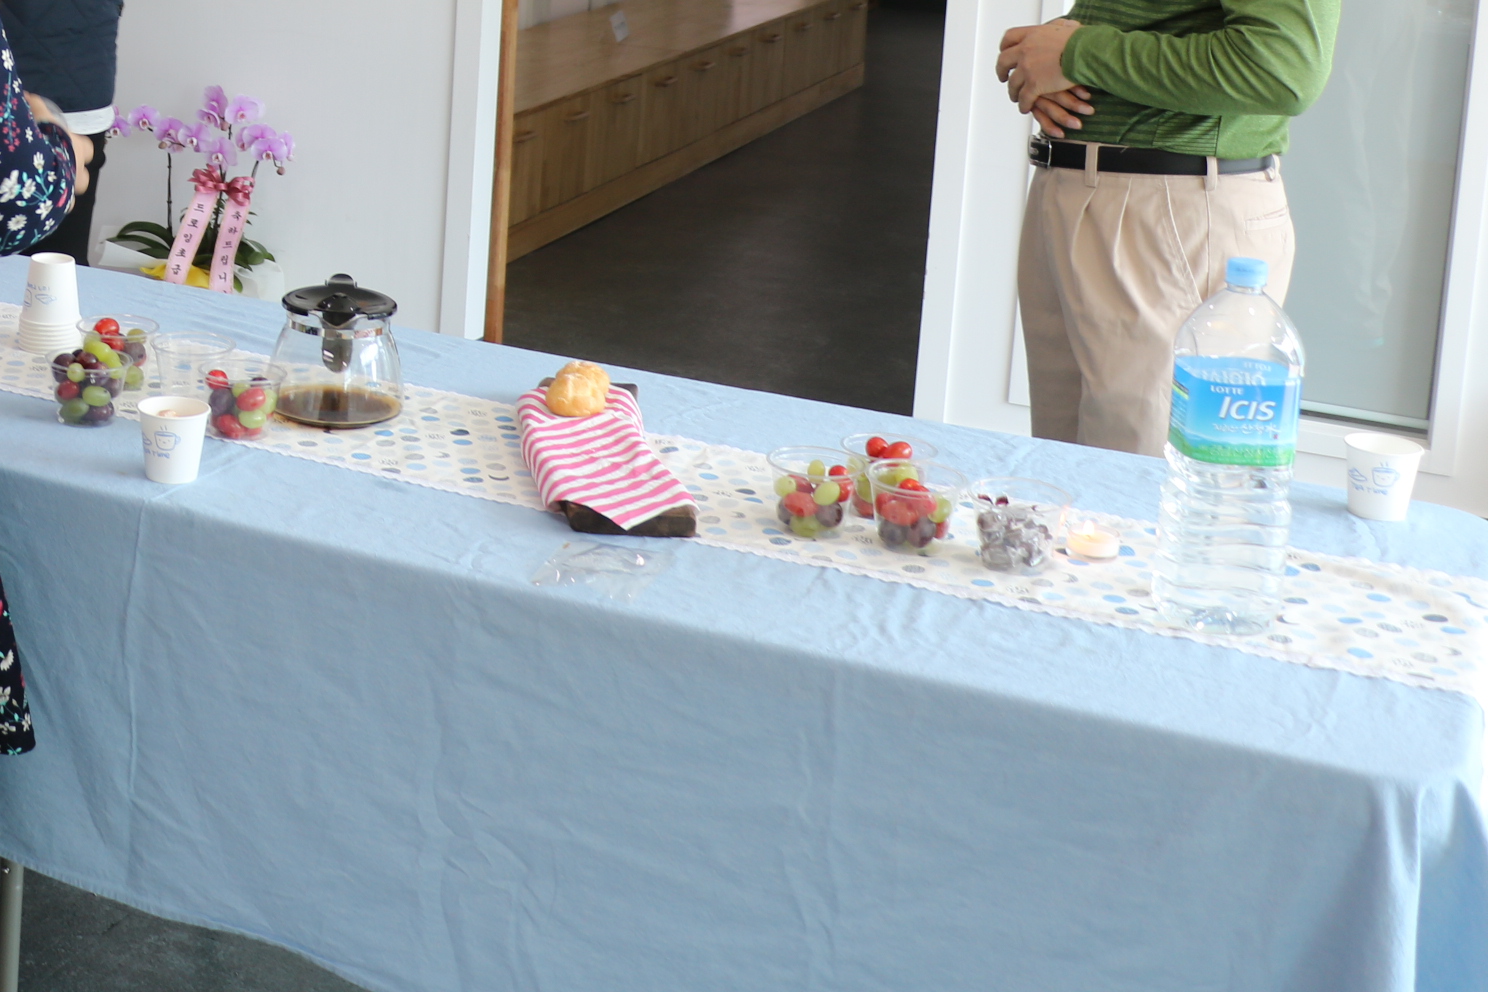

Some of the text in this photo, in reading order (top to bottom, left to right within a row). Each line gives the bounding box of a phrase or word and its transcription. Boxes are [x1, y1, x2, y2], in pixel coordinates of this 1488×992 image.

[171, 203, 205, 284] 드로잉초급
[218, 211, 242, 293] 축하드립니
[1210, 384, 1244, 396] LOTTE
[1218, 395, 1277, 421] ICIS
